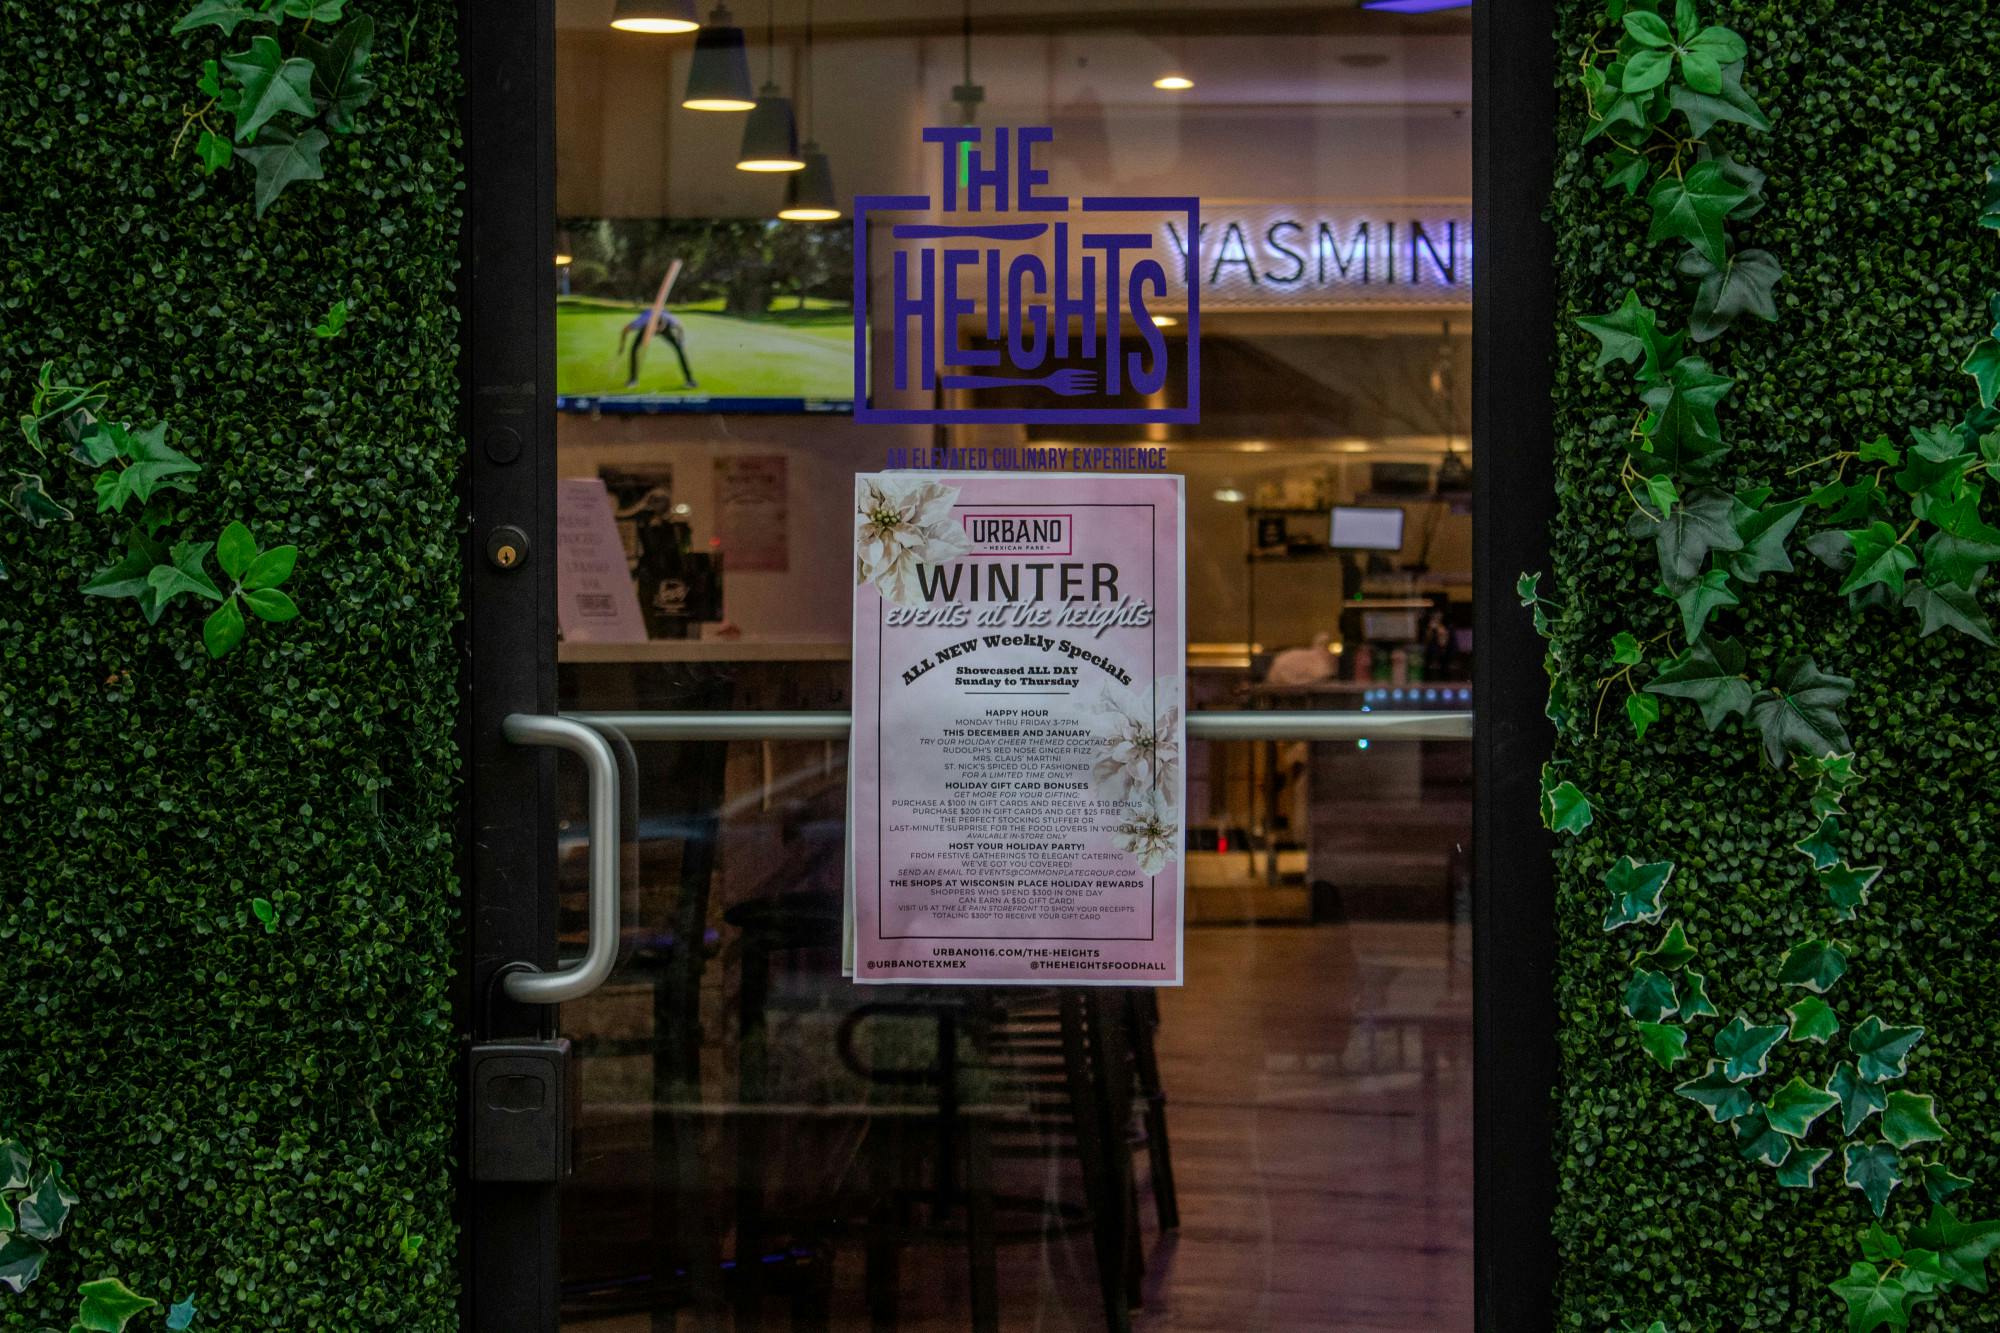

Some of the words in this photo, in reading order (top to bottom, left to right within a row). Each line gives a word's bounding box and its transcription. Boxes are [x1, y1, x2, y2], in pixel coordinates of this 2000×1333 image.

[922, 127, 1068, 212] THE
[1167, 221, 1456, 285] YASMIN
[894, 222, 1167, 396] HEIGHTS
[888, 448, 907, 470] AN
[912, 448, 987, 470] ELEVATED
[993, 448, 1066, 470] CULINARY
[1073, 448, 1167, 470] EXPERIENCE
[973, 519, 1062, 543] URBANO
[916, 563, 1120, 602] WINTER
[886, 600, 970, 627] events
[974, 602, 1006, 627] at
[1008, 597, 1053, 627] the
[1054, 595, 1154, 639] heights
[901, 659, 935, 686] ALL
[935, 639, 978, 664] NEW
[982, 633, 1055, 652] Weekly
[1058, 639, 1132, 687] Specials
[956, 666, 1023, 675] Showcased
[1027, 666, 1051, 675] ALL
[1053, 666, 1079, 675] DAY
[954, 677, 1002, 688] Sunday
[1004, 677, 1017, 687] to
[1019, 677, 1080, 688] Thursday
[1018, 880, 1048, 888] PLACE
[933, 948, 1100, 957] URBANO116.COM/THE-HEIGHTS
[867, 960, 966, 969] @URBANOTEXMEX
[1030, 961, 1166, 970] @THEHEIGHTSFOODHALL
